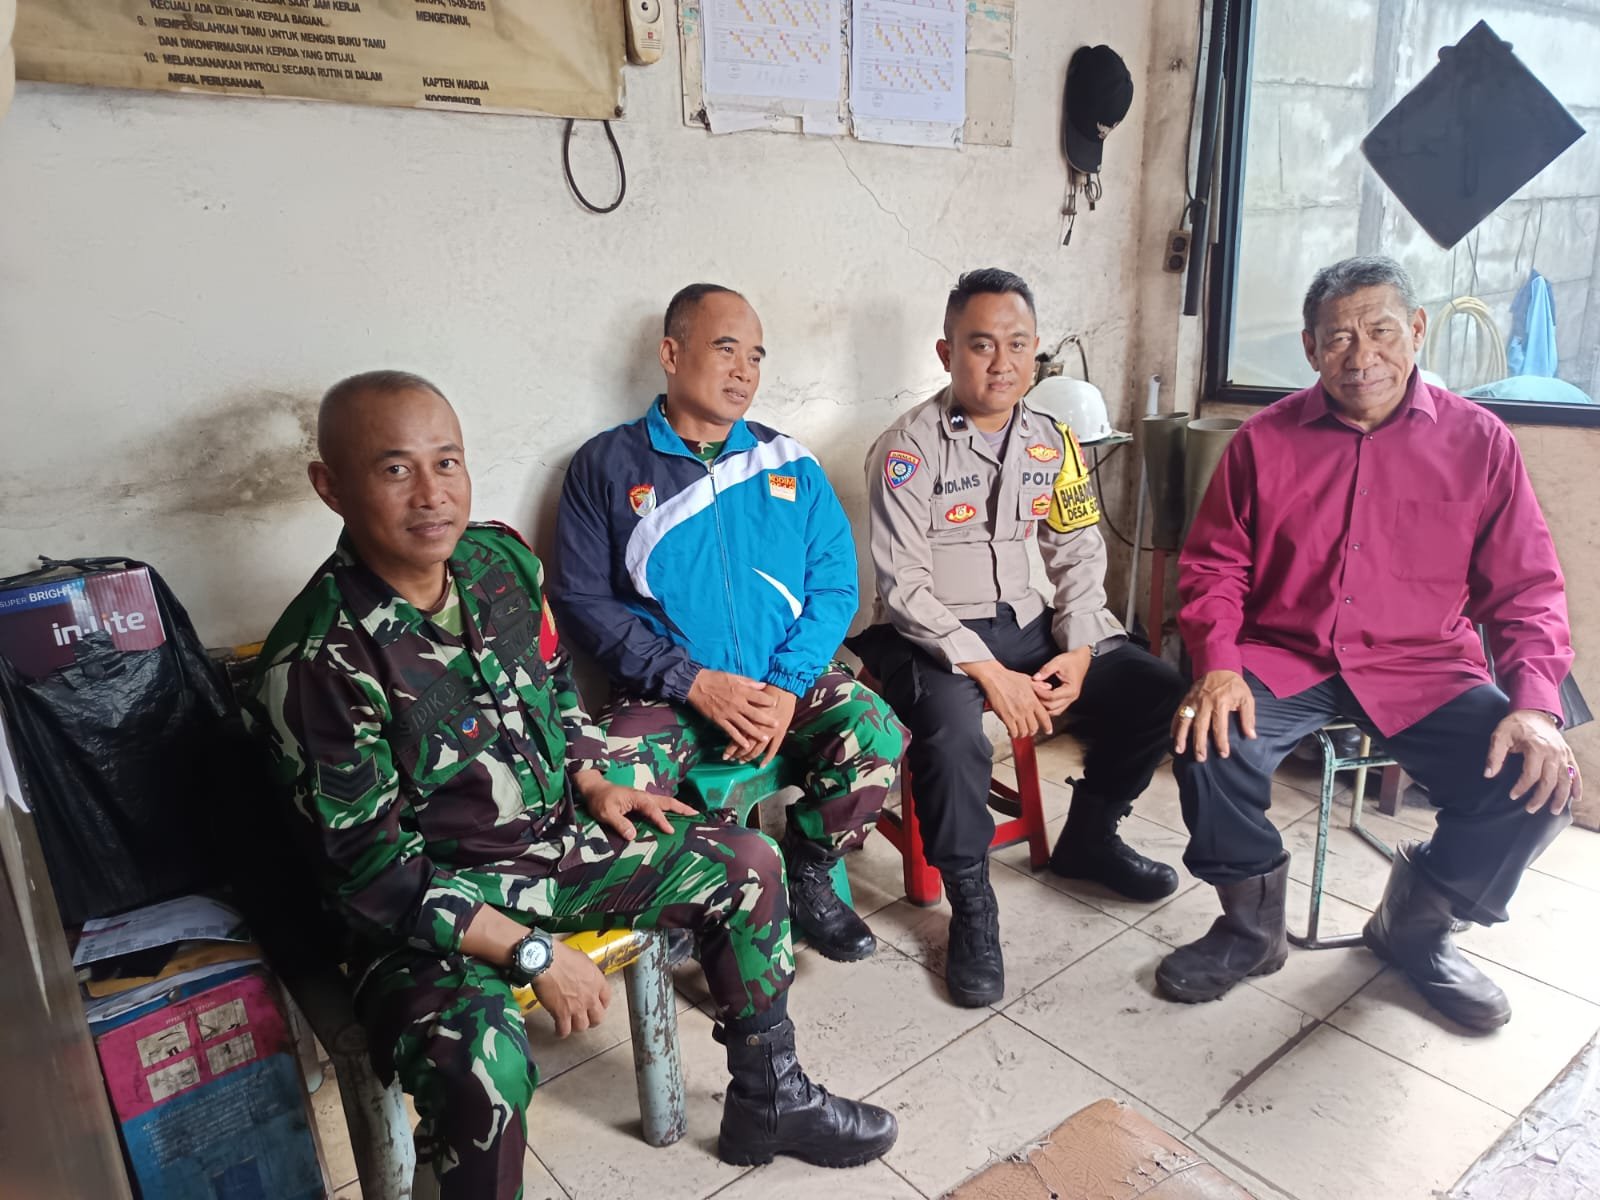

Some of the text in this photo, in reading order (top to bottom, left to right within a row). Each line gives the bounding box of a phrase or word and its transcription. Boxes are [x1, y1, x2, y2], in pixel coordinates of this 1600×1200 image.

[150, 0, 191, 12] KECUALI
[194, 3, 213, 14] ADA
[214, 5, 234, 17] IZIN
[235, 8, 255, 19] DARI
[257, 11, 290, 23] KEPALA
[313, 0, 331, 10] JAM
[333, 1, 361, 13] KERJA
[137, 15, 386, 49] 9. MEMPERSILAHKAN TAMU UNTUK MENGISI BUKU TAMU
[158, 36, 178, 47] DAN
[180, 38, 263, 55] DIKONFIRMASIKAN
[266, 45, 300, 58] KEPADA
[300, 49, 323, 60] YANG
[144, 52, 383, 81] 10. MELAKSANAKAN PATROLI SECARA RUTIN DI DALAM
[168, 72, 199, 84] AREAL
[422, 76, 490, 91] KAPTEN WARDJA
[1067, 504, 1088, 521] DESA
[0, 583, 74, 608] SUPER BRIGHT
